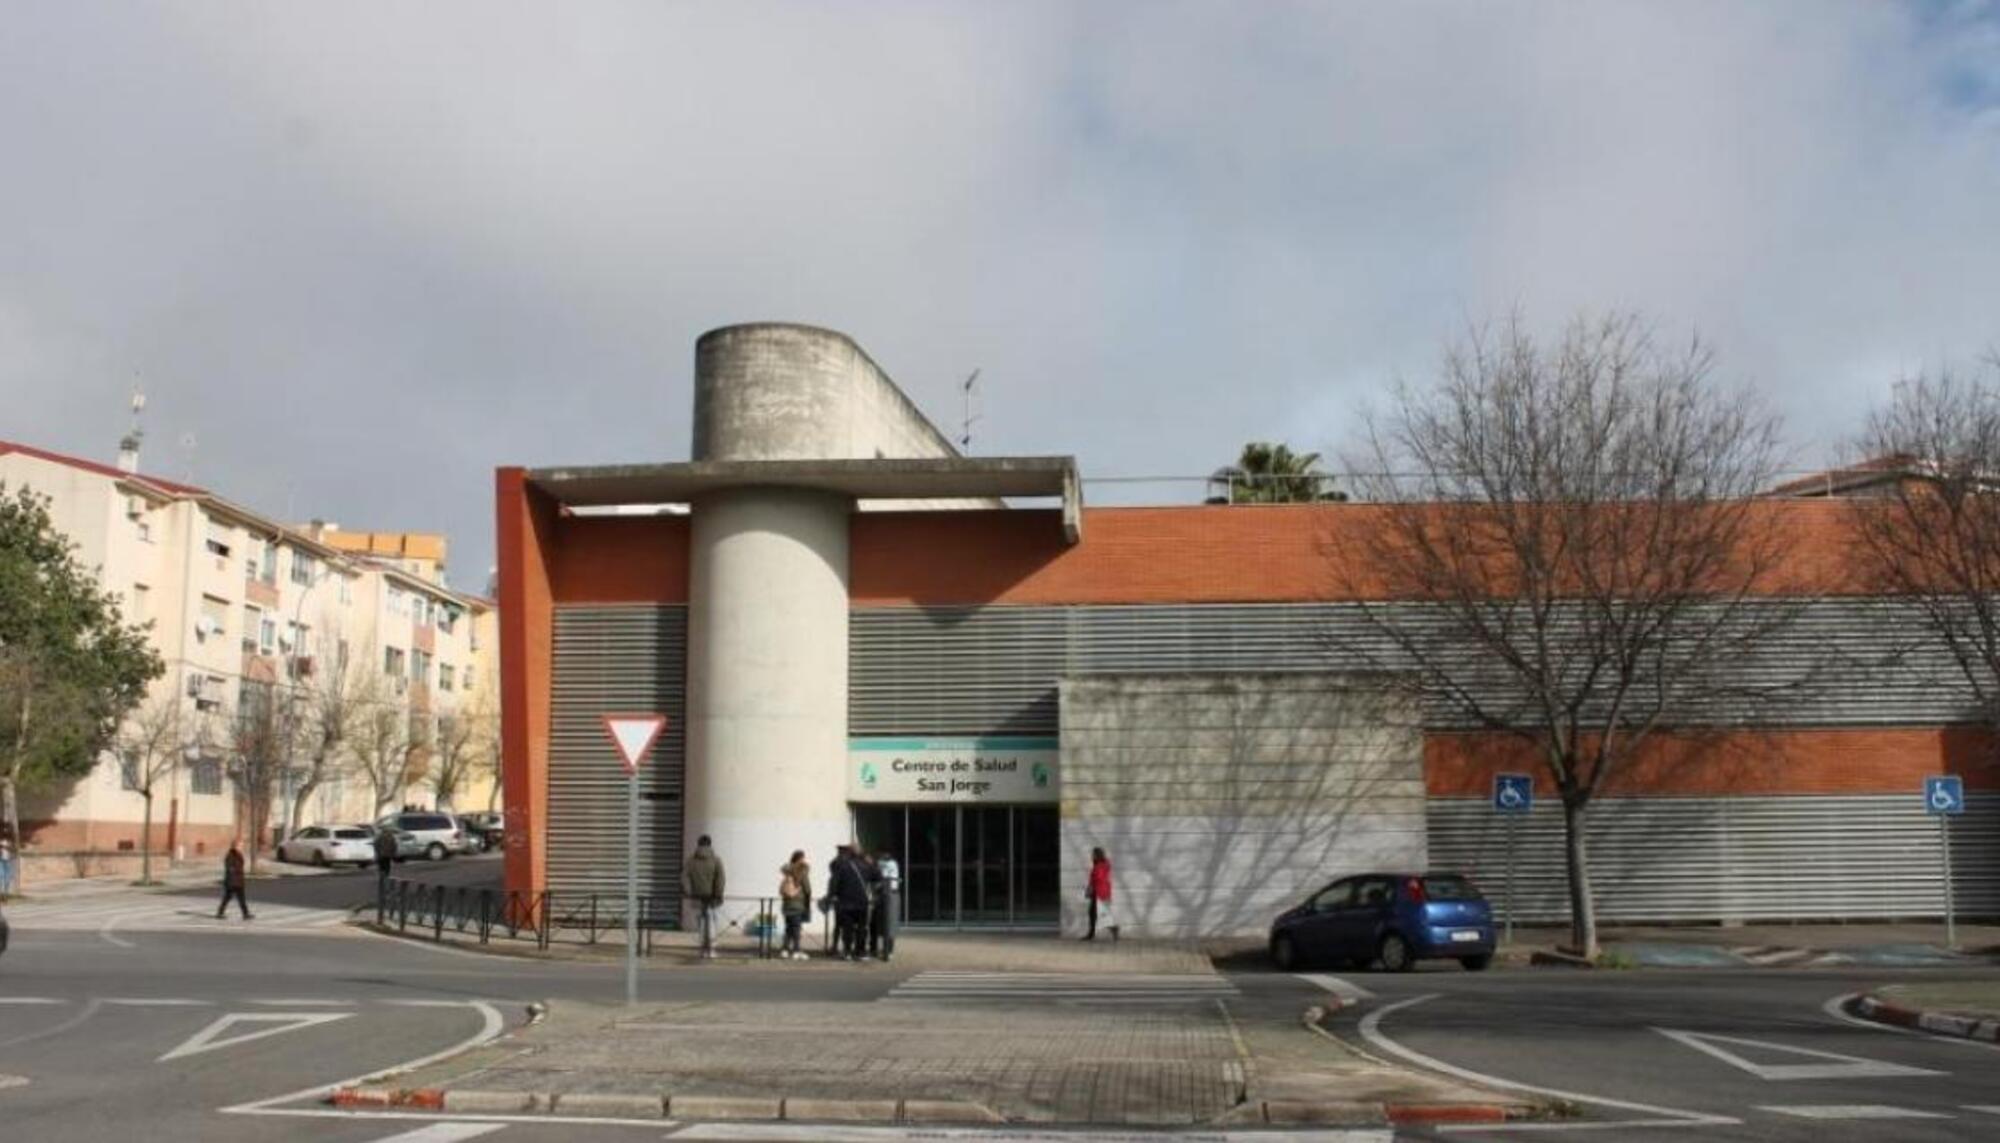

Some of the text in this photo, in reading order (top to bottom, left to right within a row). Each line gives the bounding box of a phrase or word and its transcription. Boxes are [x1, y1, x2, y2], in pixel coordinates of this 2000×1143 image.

[892, 757, 1017, 772] Centro de Salud
[917, 778, 991, 795] San Jorge
